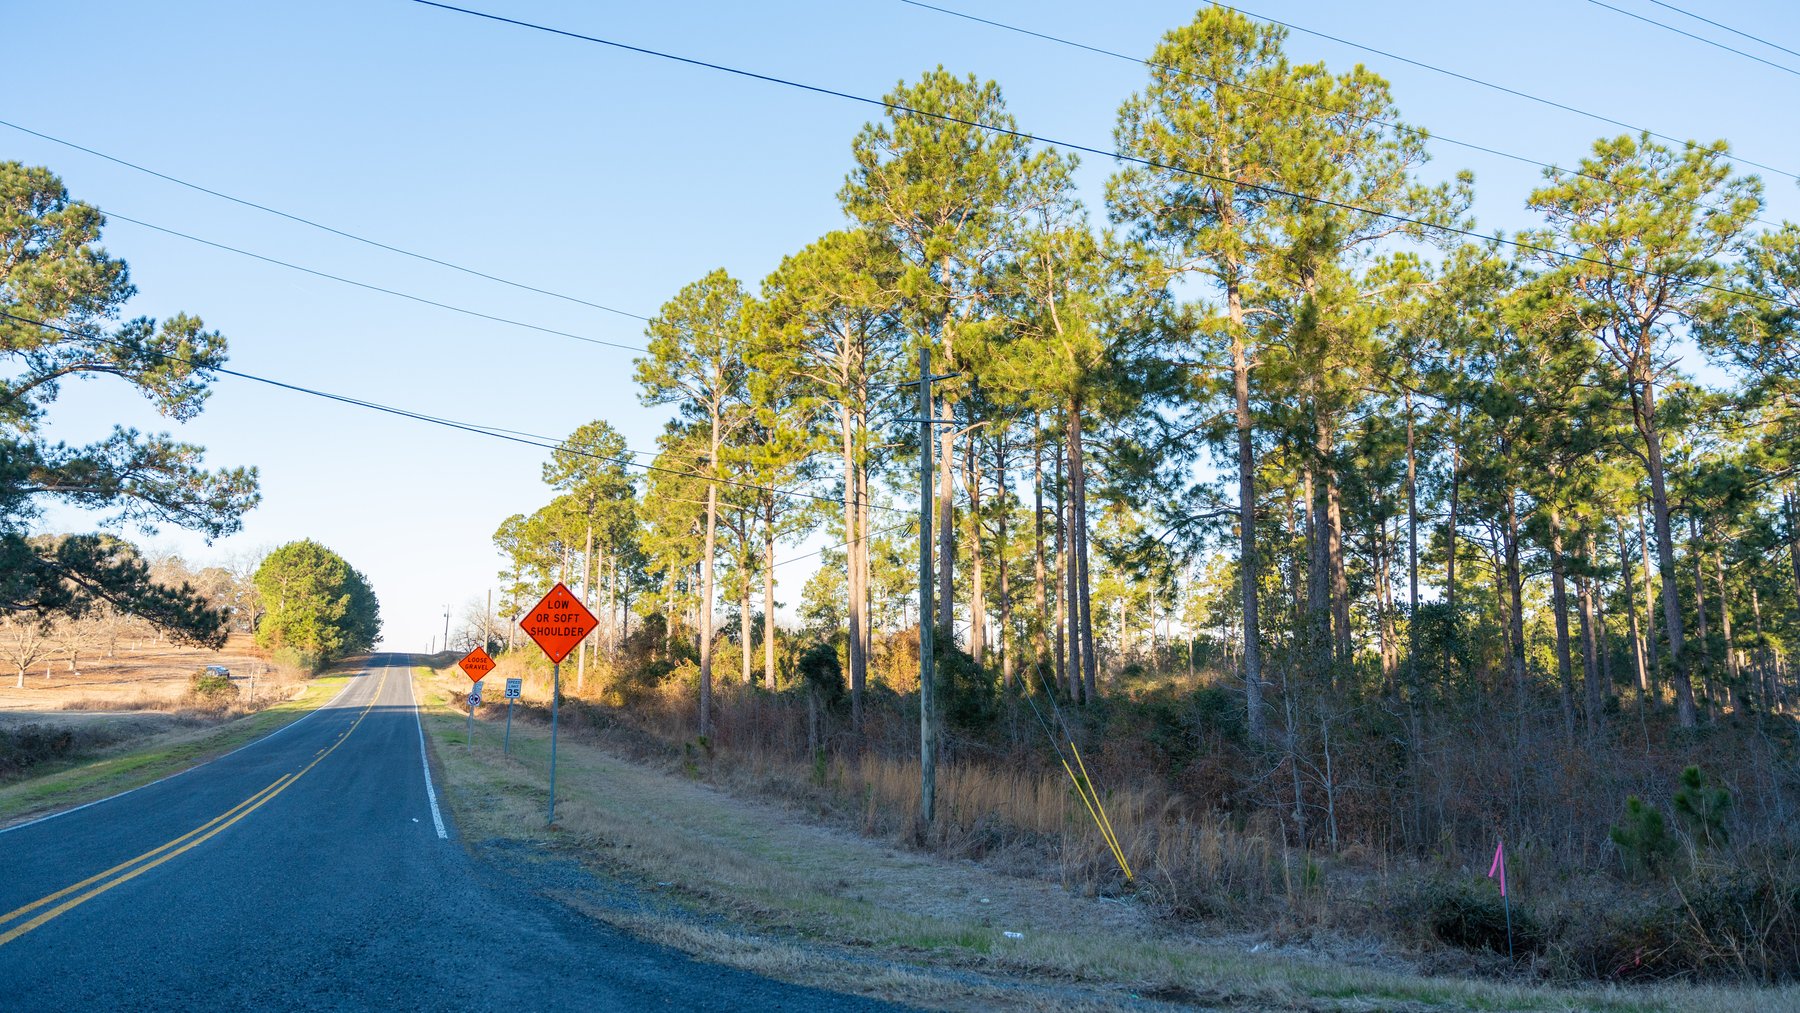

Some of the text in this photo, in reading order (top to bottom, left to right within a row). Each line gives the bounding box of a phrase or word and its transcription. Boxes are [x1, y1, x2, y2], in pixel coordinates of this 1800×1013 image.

[547, 600, 569, 609] LOW
[536, 613, 579, 622] OR SOFT
[531, 627, 584, 636] SHOULDER
